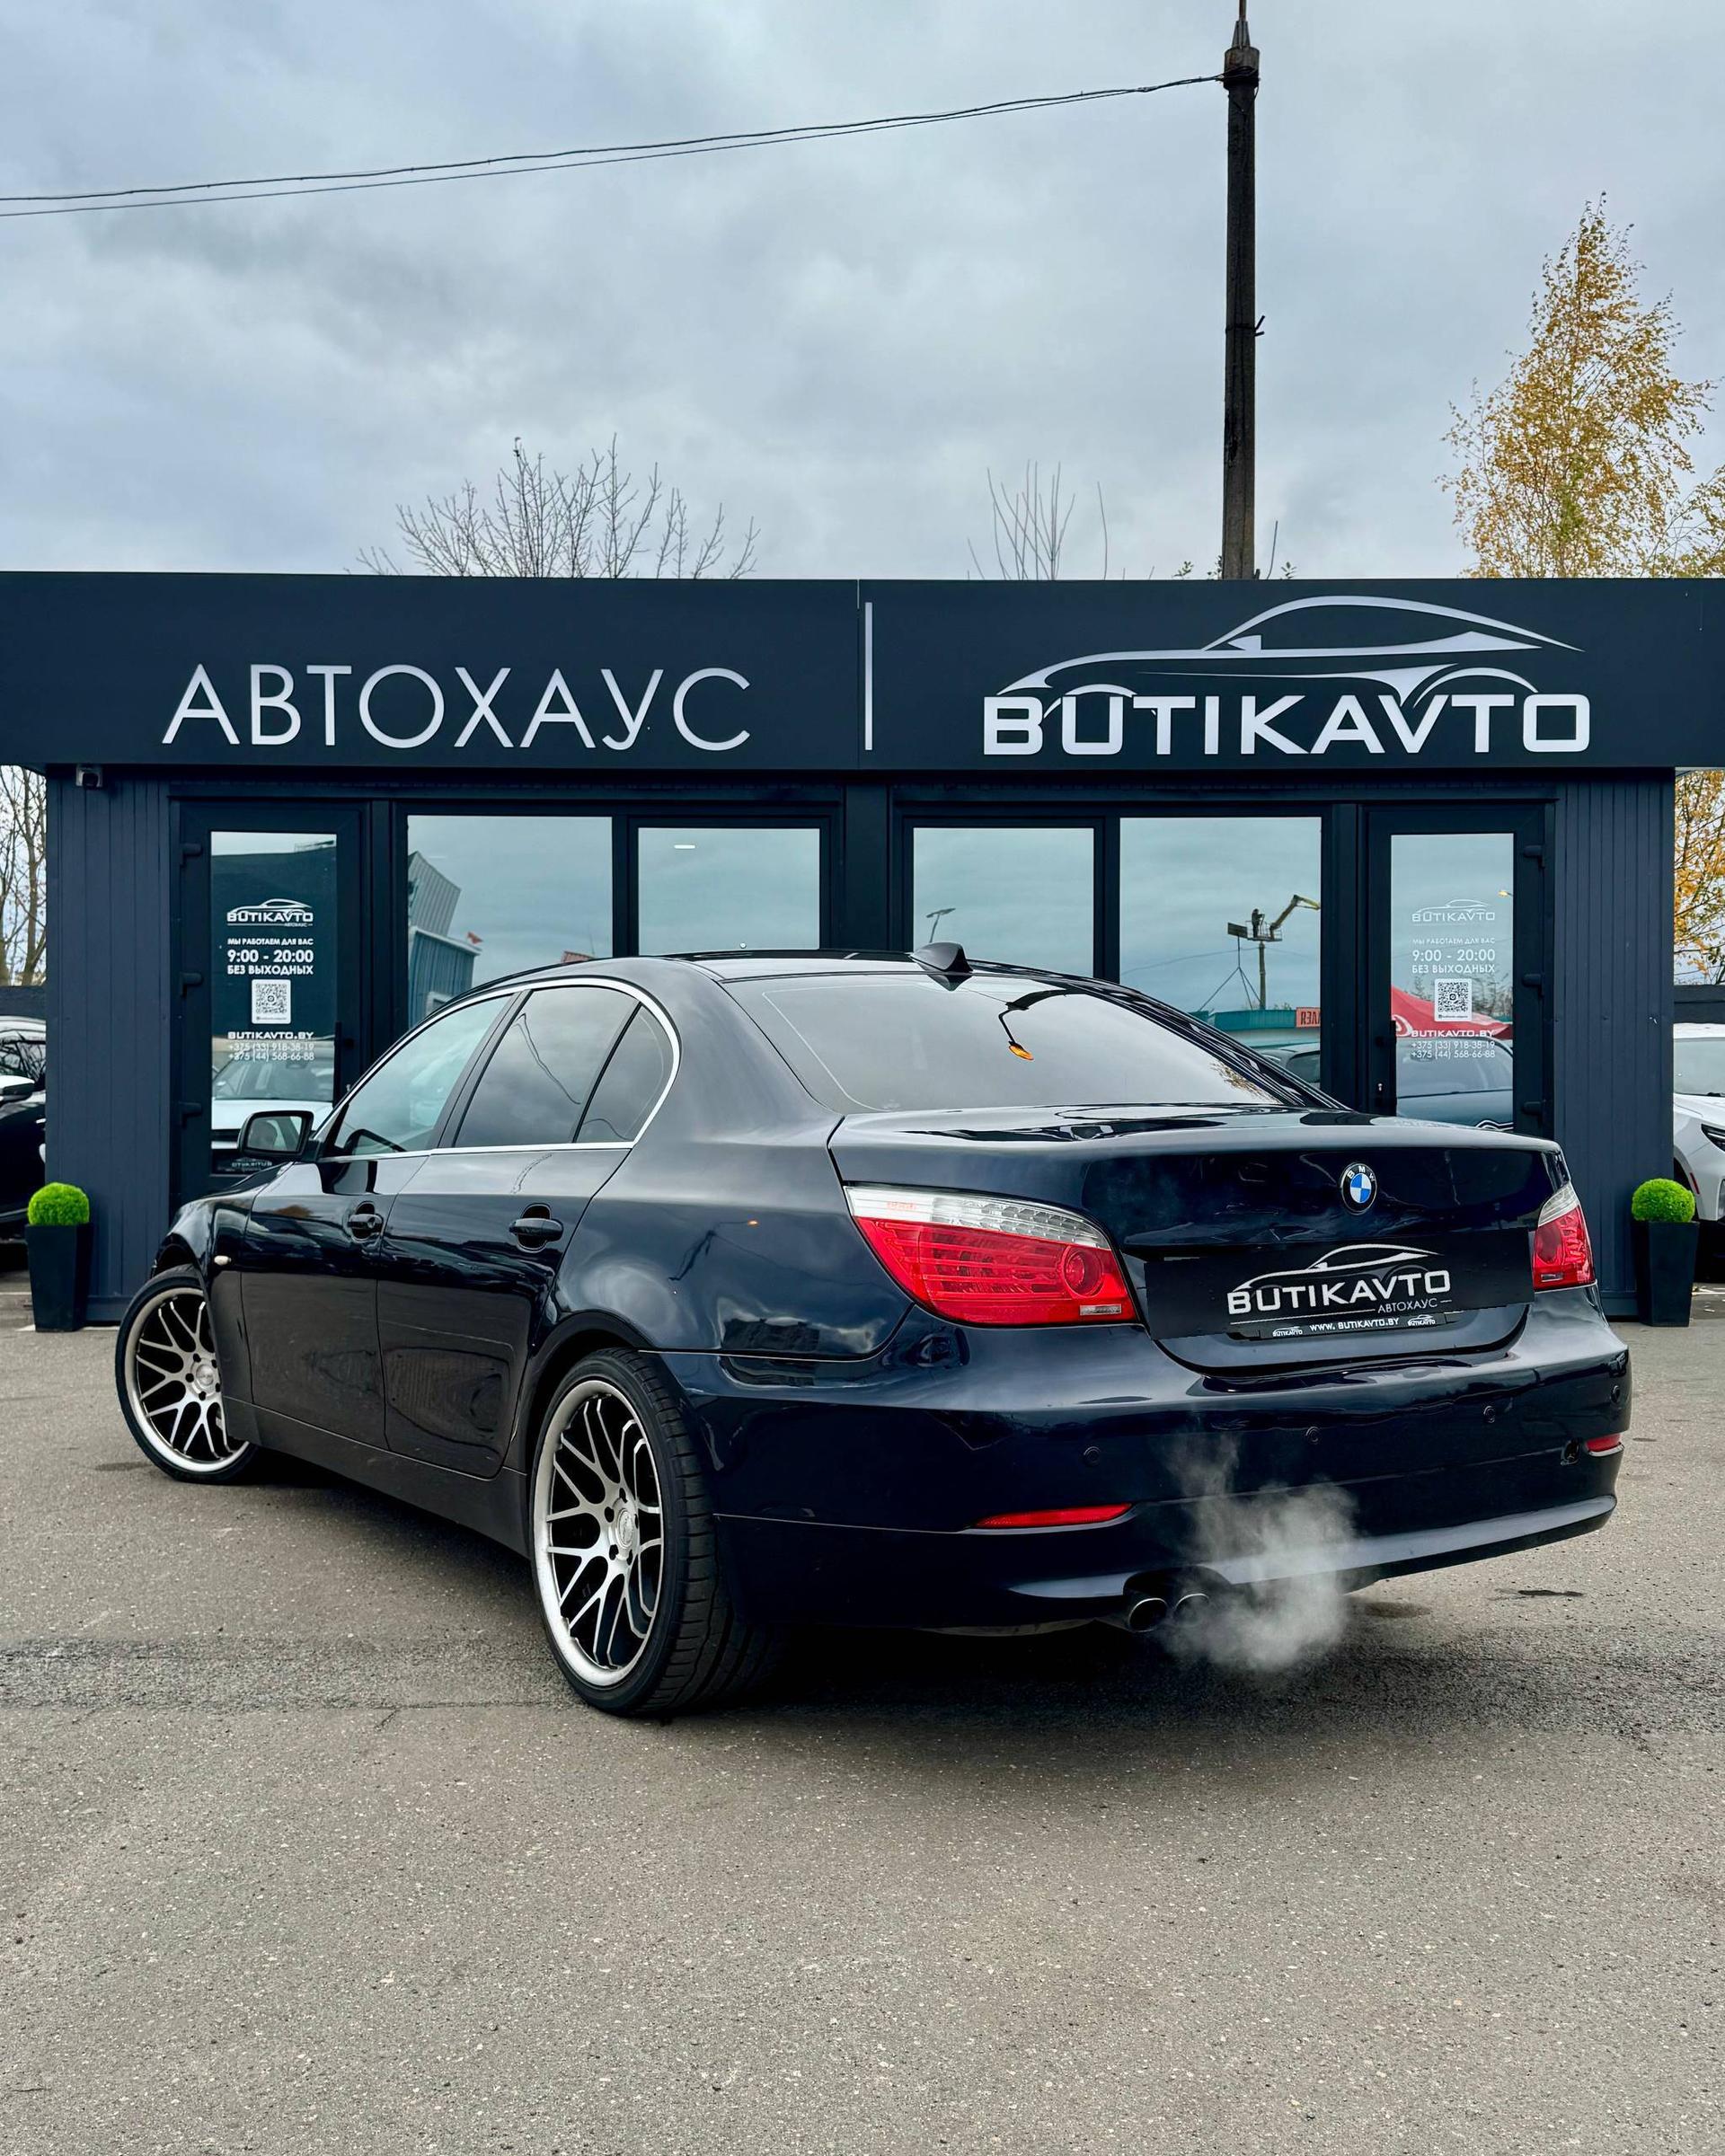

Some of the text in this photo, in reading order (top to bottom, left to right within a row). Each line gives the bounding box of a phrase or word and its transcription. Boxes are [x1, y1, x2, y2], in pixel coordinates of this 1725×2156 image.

[162, 663, 751, 752] АВТОХАУС
[983, 693, 1590, 755] BUTIKAVTO
[226, 912, 314, 923] BUTIKAVTO
[1411, 912, 1496, 922] BUTIKAVTO
[227, 950, 259, 963] 9:00
[273, 950, 314, 963] 20:00
[1412, 950, 1442, 962] 9:00
[1456, 949, 1496, 961] 20:00
[227, 965, 314, 976] БЕЗ ВЫХОДНЫХ
[1411, 965, 1495, 974] БЕЗ ВЫХОДНЫХ
[1435, 1040, 1450, 1050] (33)
[252, 1052, 270, 1062] (44)
[271, 1052, 314, 1060] 568-66-88
[1435, 1050, 1451, 1059] (44)
[1347, 1165, 1376, 1182] BMW
[1226, 1269, 1451, 1315] BUTIKAVTO
[1377, 1297, 1438, 1314] АВТОХАУС
[1407, 1318, 1436, 1327] BUTIKAVTO
[1272, 1329, 1304, 1337] BUTIKAVTO
